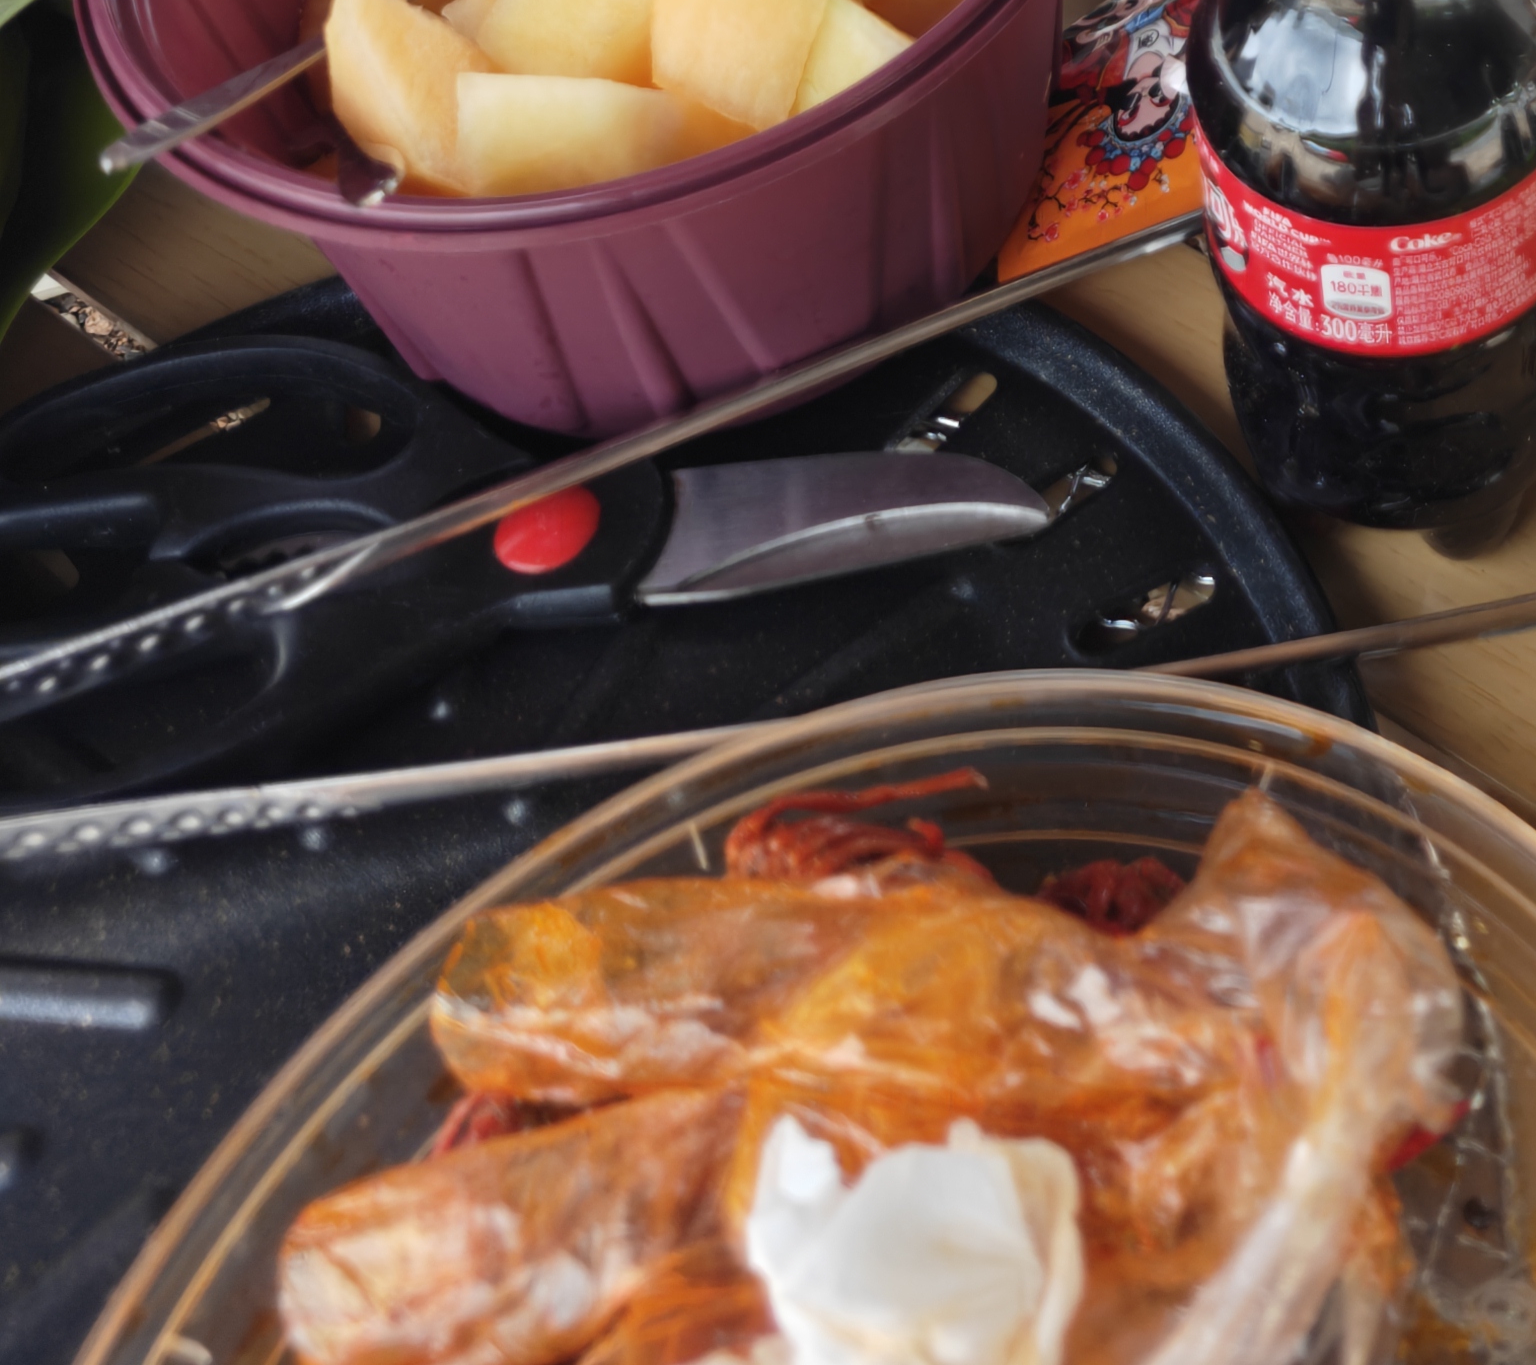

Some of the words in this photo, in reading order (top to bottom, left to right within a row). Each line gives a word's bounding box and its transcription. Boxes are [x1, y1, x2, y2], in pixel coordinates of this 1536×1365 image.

[1390, 233, 1454, 253] Coke
[1267, 271, 1315, 309] 汽水
[1268, 291, 1393, 345] 净含量:300毫升
